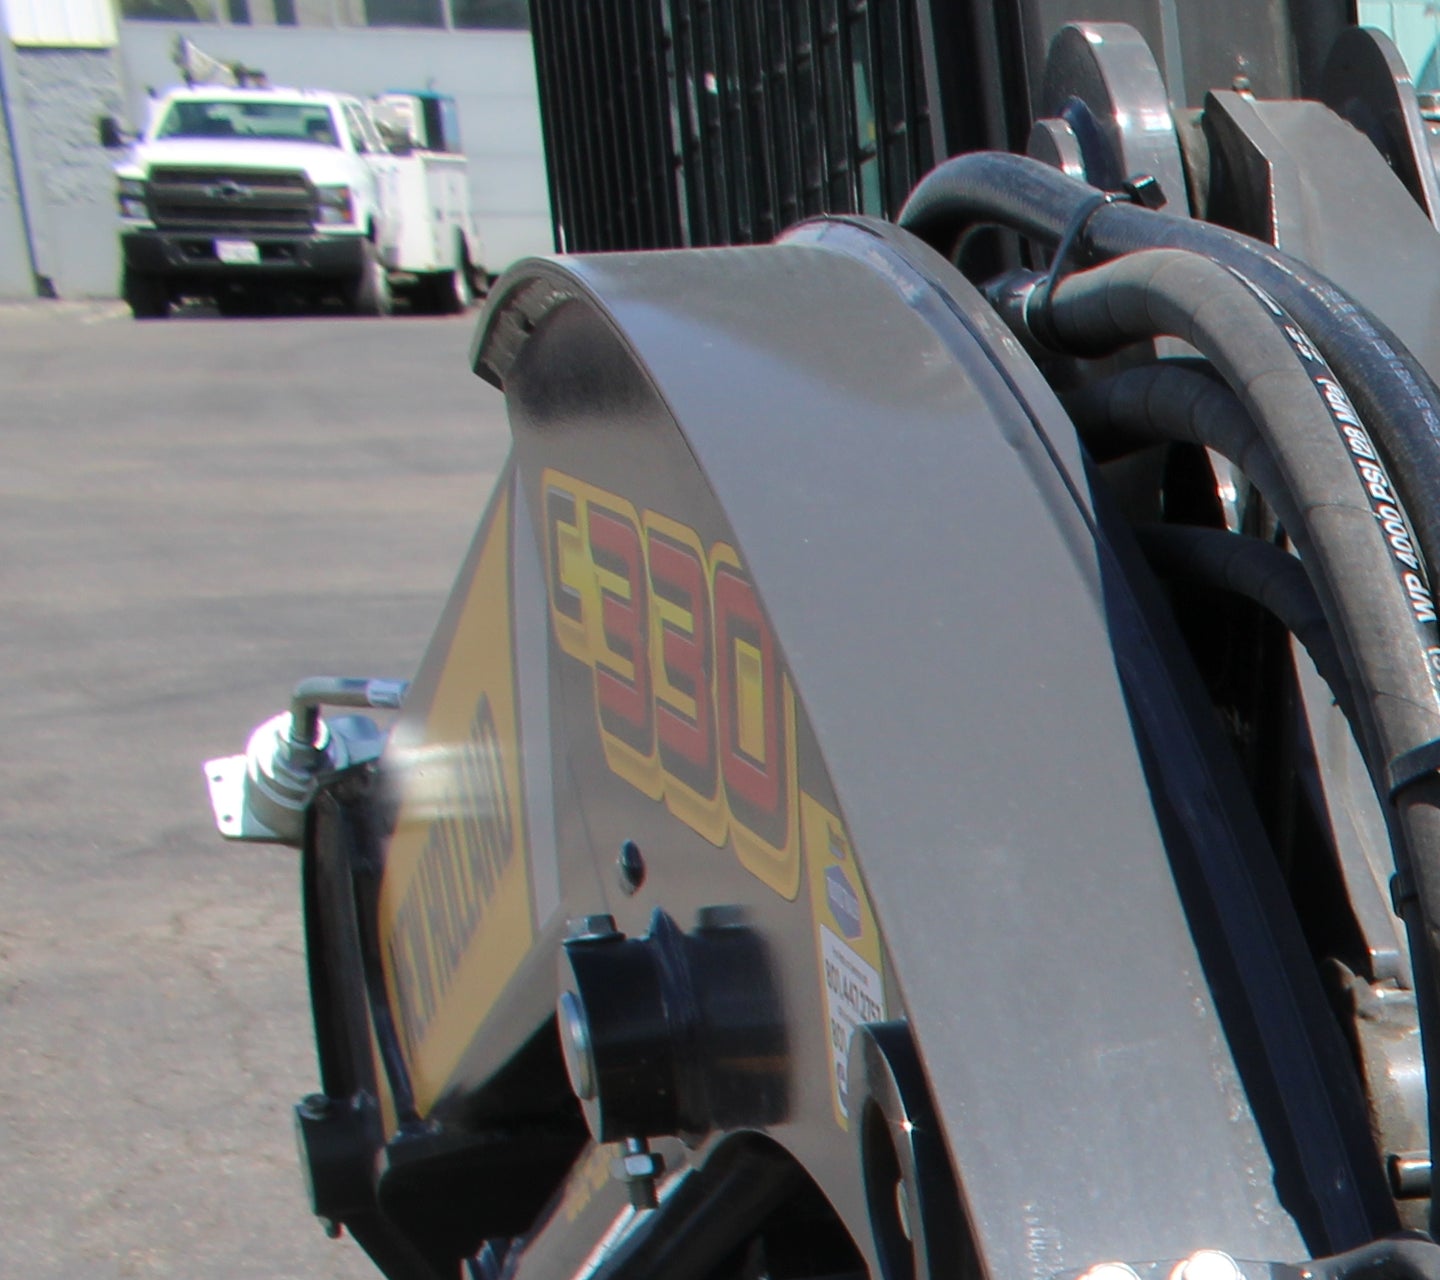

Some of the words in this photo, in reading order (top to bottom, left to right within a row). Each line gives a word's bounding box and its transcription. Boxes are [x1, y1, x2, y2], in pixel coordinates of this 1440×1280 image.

[1357, 459, 1397, 505] PSI
[1376, 503, 1419, 570] 4000
[1404, 571, 1438, 624] WP
